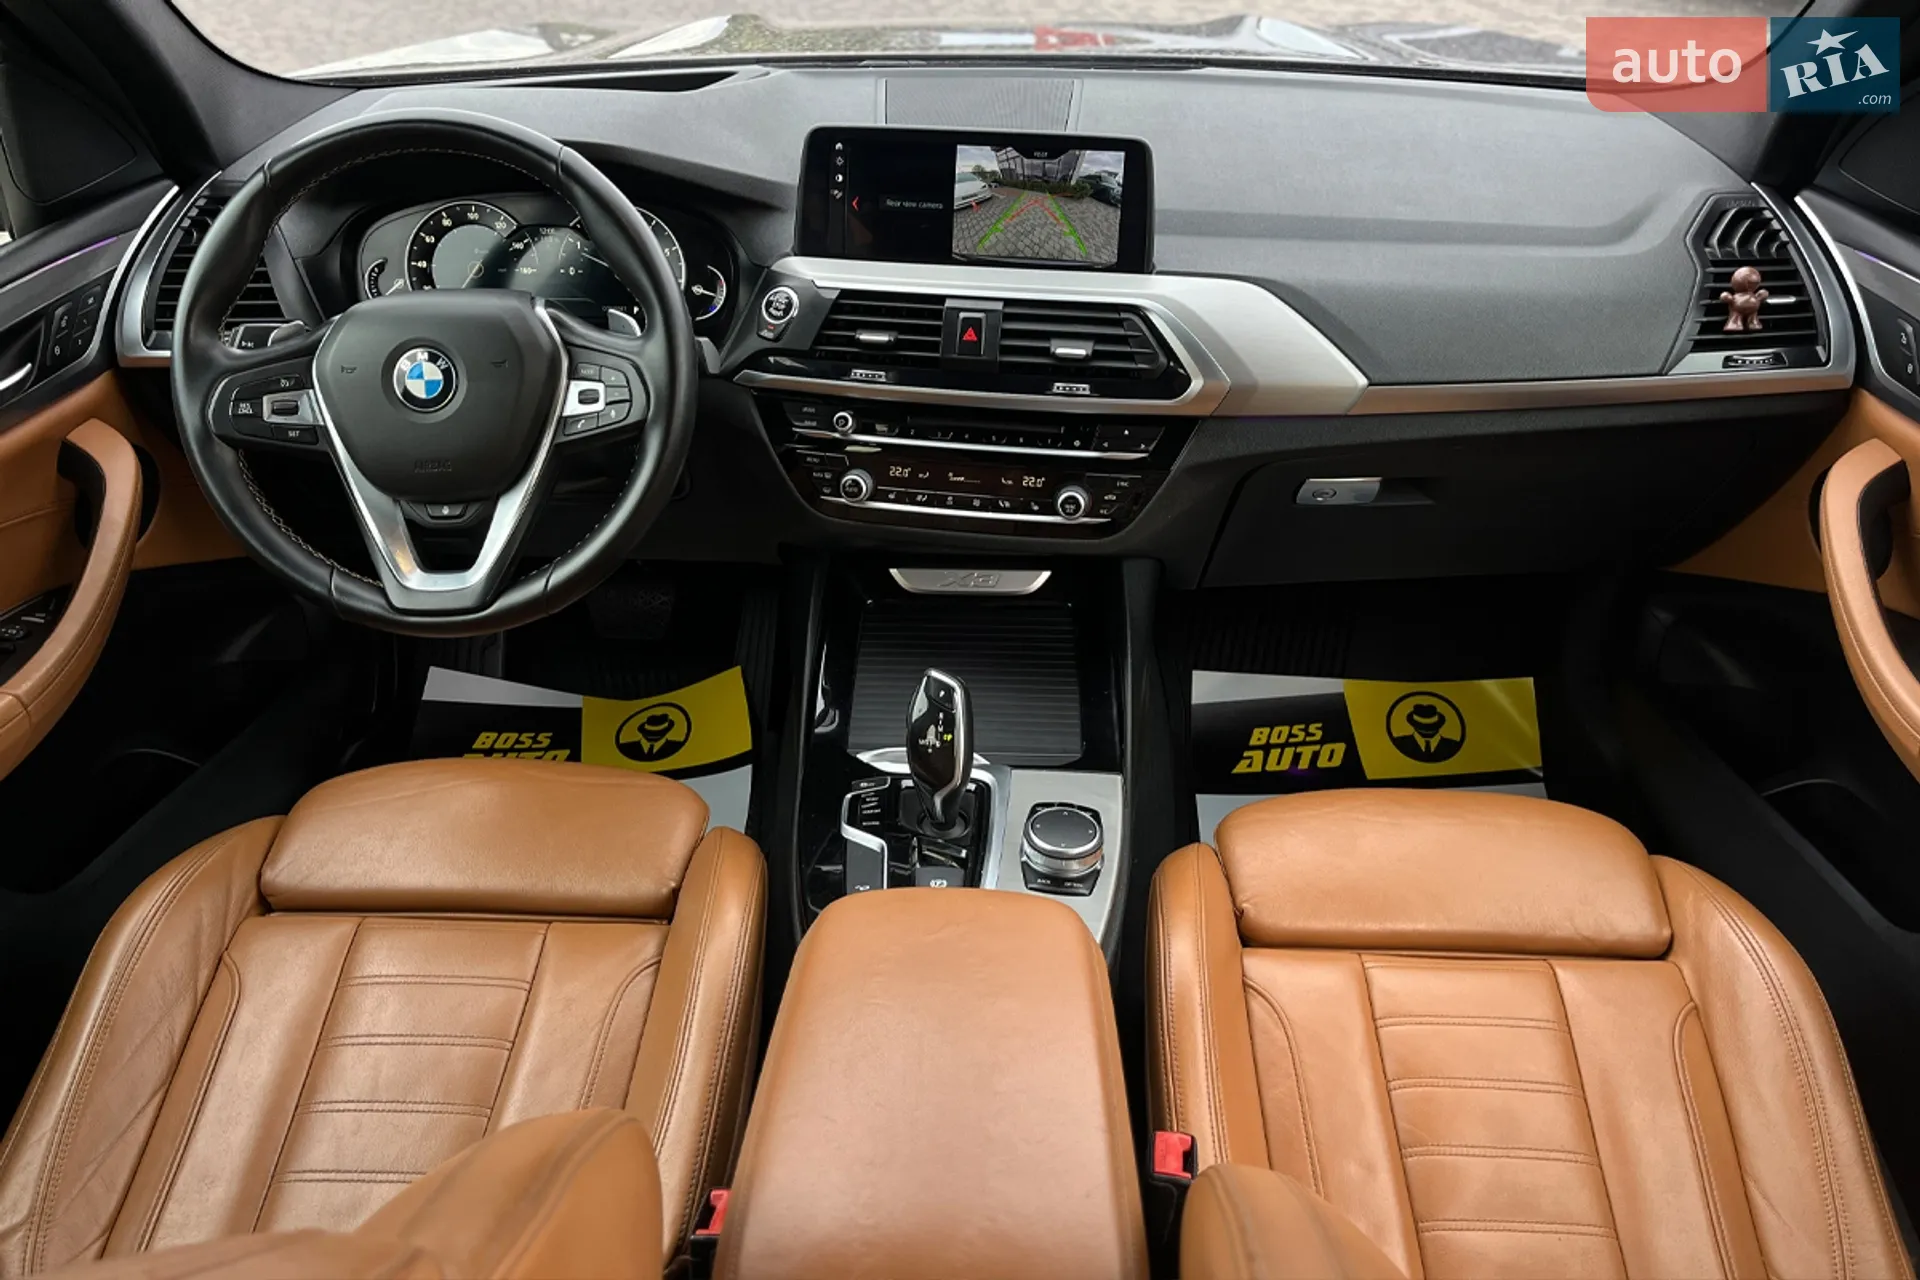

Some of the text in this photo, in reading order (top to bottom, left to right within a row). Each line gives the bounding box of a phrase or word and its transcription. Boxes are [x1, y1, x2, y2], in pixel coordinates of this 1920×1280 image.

[568, 266, 576, 277] 0
[400, 351, 450, 371] BMW
[937, 570, 1000, 588] X3
[472, 731, 553, 749] BOSS
[1249, 723, 1323, 746] BOSS
[1231, 742, 1346, 774] AUTO
